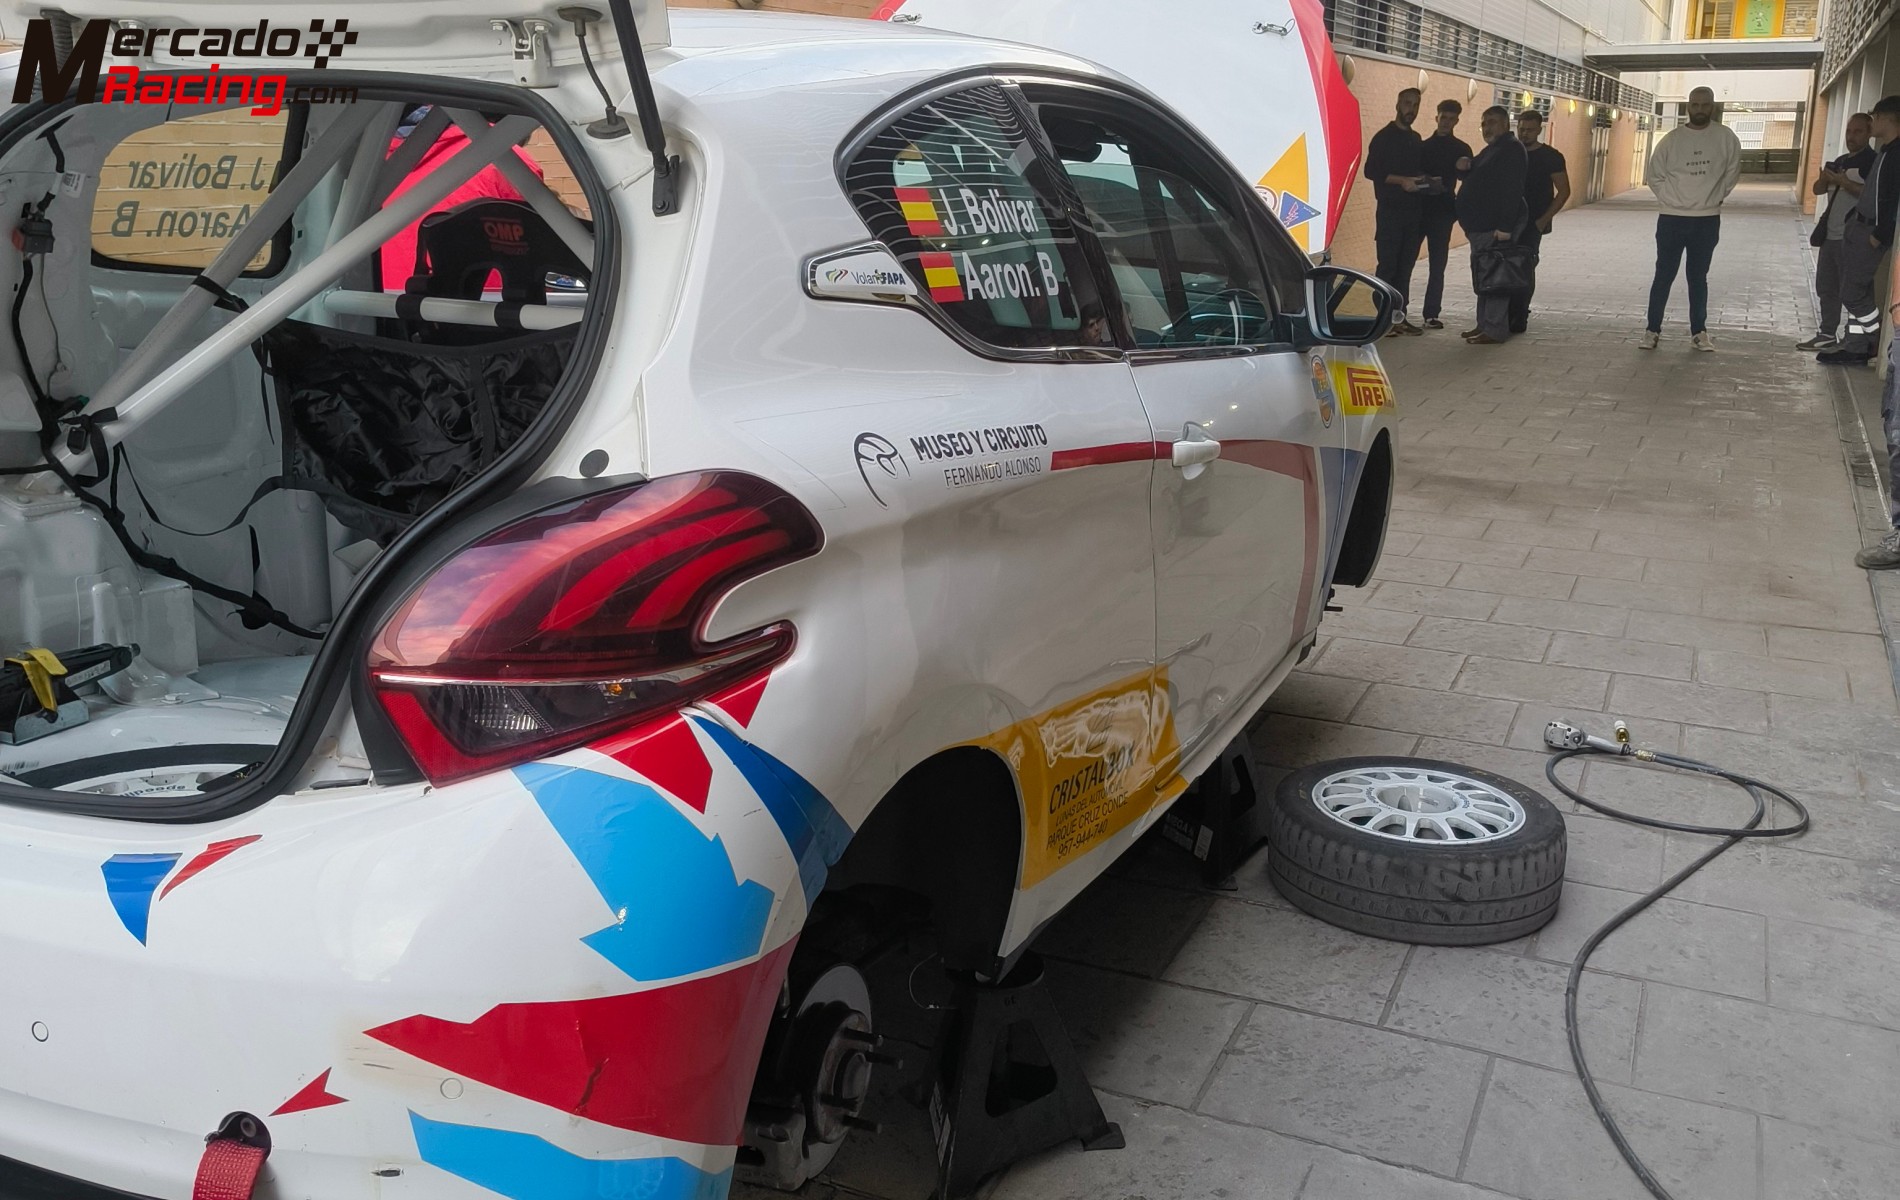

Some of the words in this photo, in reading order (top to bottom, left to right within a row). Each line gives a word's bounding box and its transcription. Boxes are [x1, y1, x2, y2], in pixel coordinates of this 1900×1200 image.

[483, 221, 525, 241] OMP
[938, 188, 967, 236] J.
[958, 187, 1040, 235] Bolivar
[961, 251, 1041, 300] Aaron.
[1036, 252, 1060, 297] B
[910, 431, 974, 461] MUSEO
[968, 430, 985, 453] Y
[983, 423, 1048, 453] CIRCUITO
[943, 462, 1003, 487] FERNANDO
[1004, 456, 1042, 477] ALONSO
[1046, 819, 1079, 850] PARQUE
[1078, 806, 1102, 829] CRUZ
[1101, 791, 1130, 817] CONDE
